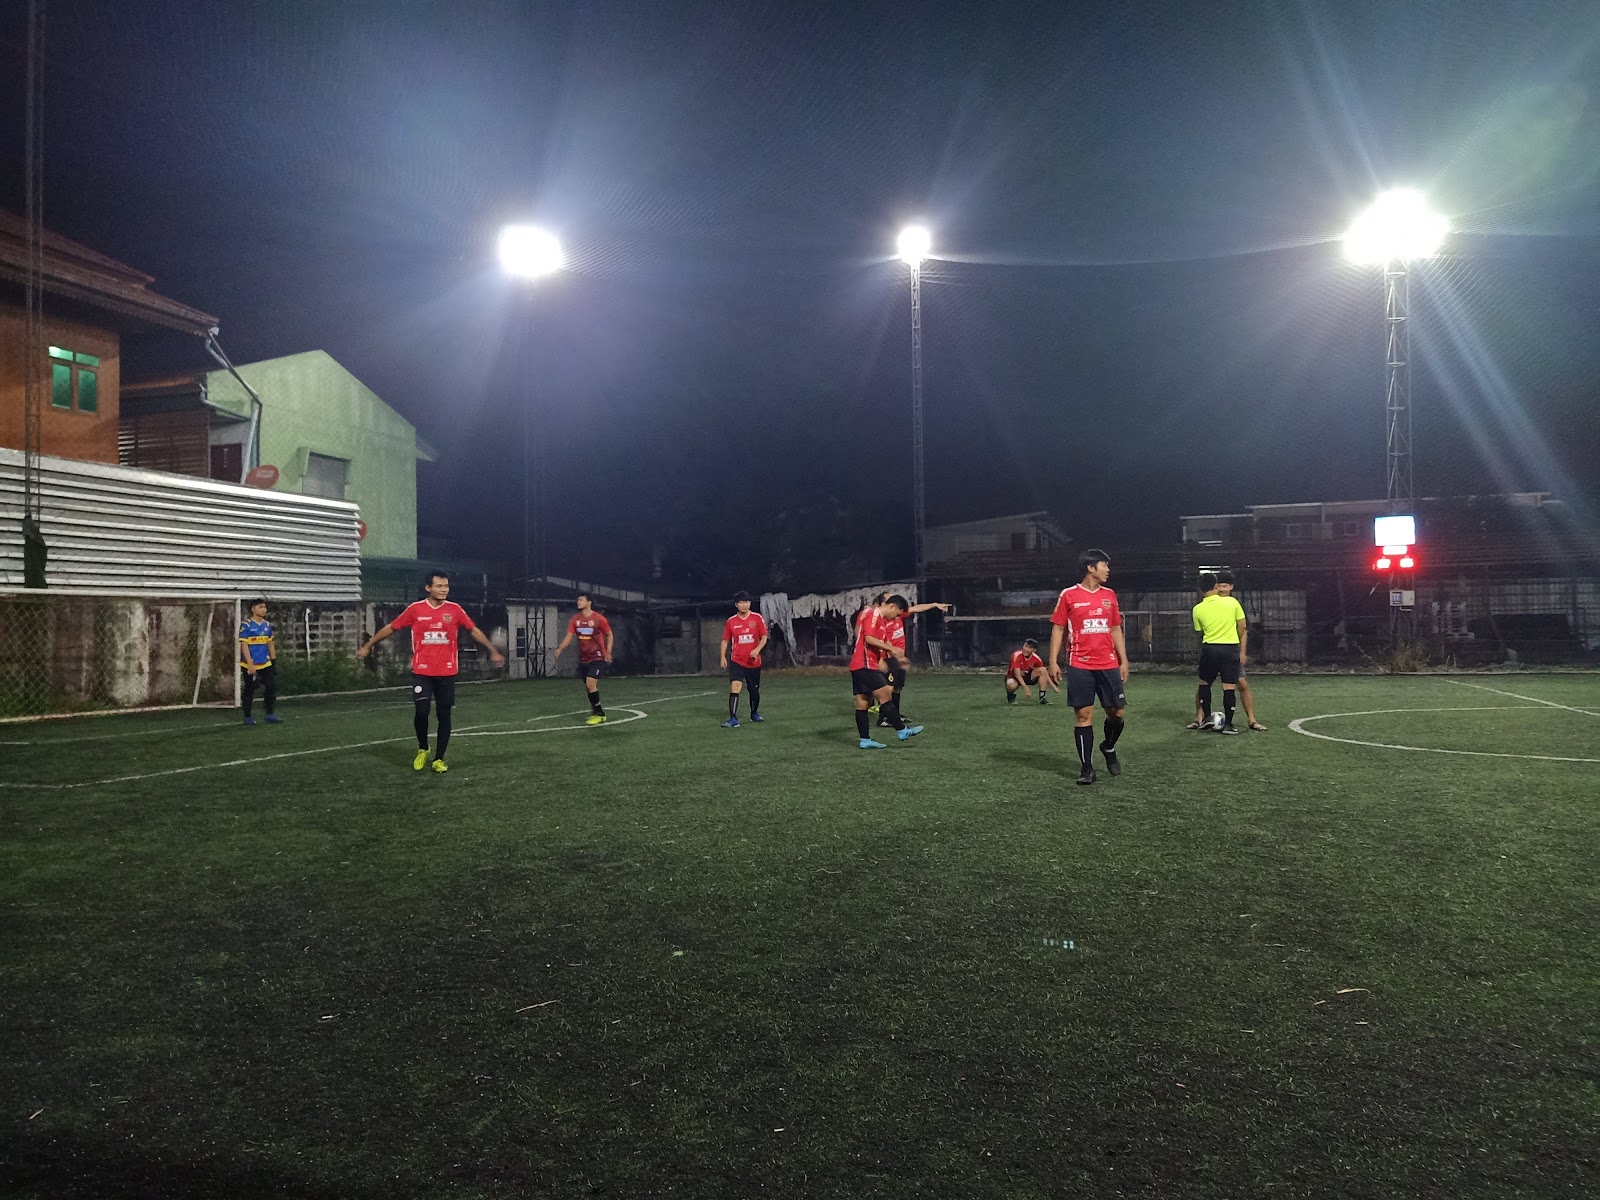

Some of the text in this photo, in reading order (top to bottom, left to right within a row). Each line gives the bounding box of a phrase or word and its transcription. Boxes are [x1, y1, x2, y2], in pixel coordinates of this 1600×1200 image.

[1083, 618, 1109, 628] SKY
[424, 631, 447, 640] SKY
[888, 673, 894, 682] 6
